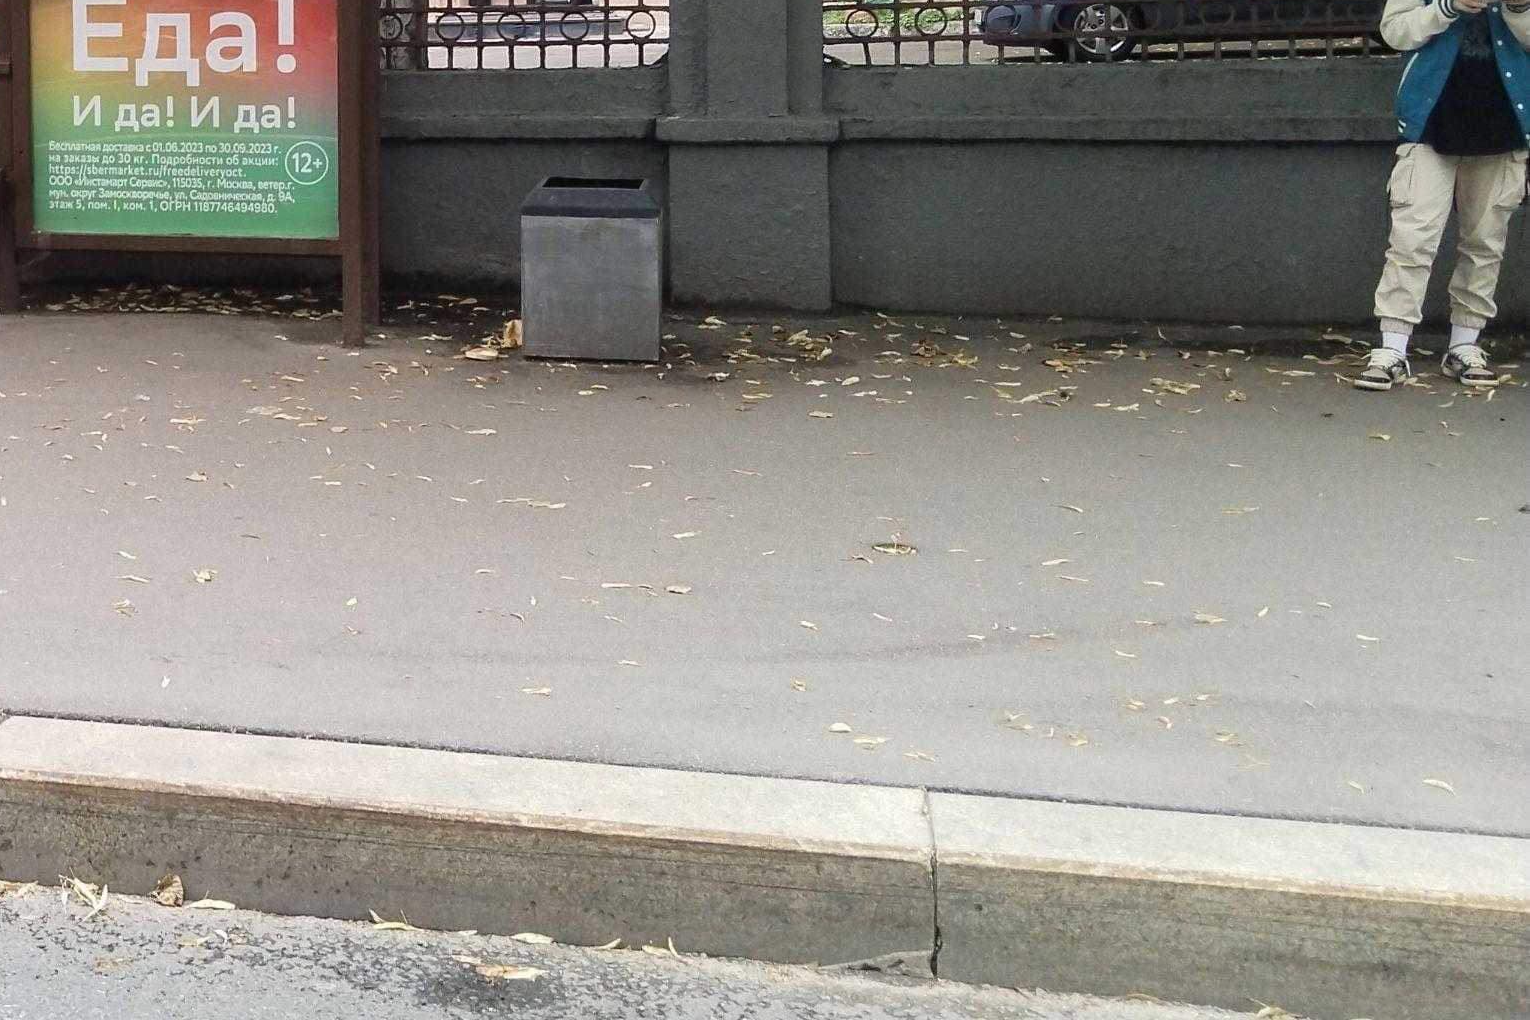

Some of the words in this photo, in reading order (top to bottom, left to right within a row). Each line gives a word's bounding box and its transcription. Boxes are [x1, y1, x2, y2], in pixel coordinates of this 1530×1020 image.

[73, 95, 101, 127] И
[114, 96, 174, 132] да!
[190, 96, 220, 128] И
[233, 96, 296, 134] да!
[48, 140, 101, 152] Бесплатная
[102, 143, 144, 153] доставка
[152, 142, 203, 154] 01.06.2023
[205, 144, 217, 153] по
[218, 142, 272, 154] 30.09.2023
[273, 145, 281, 154] г.
[48, 155, 60, 163] на
[64, 155, 99, 163] заказы
[102, 155, 115, 164] до
[118, 153, 131, 164] 30
[133, 155, 148, 164] кг.
[152, 154, 222, 166] Подробности
[225, 154, 239, 164] об
[242, 156, 278, 167] акции:
[291, 153, 323, 173] 12+
[49, 175, 72, 186] ООО
[173, 178, 205, 190] 115035,
[207, 180, 214, 188] г.
[217, 179, 256, 190] Москва,
[71, 189, 96, 200] округ
[49, 200, 73, 209] этаж
[76, 199, 85, 211] 5,
[88, 201, 110, 210] пом.
[123, 201, 146, 211] ком.
[160, 201, 190, 212] ОГРН
